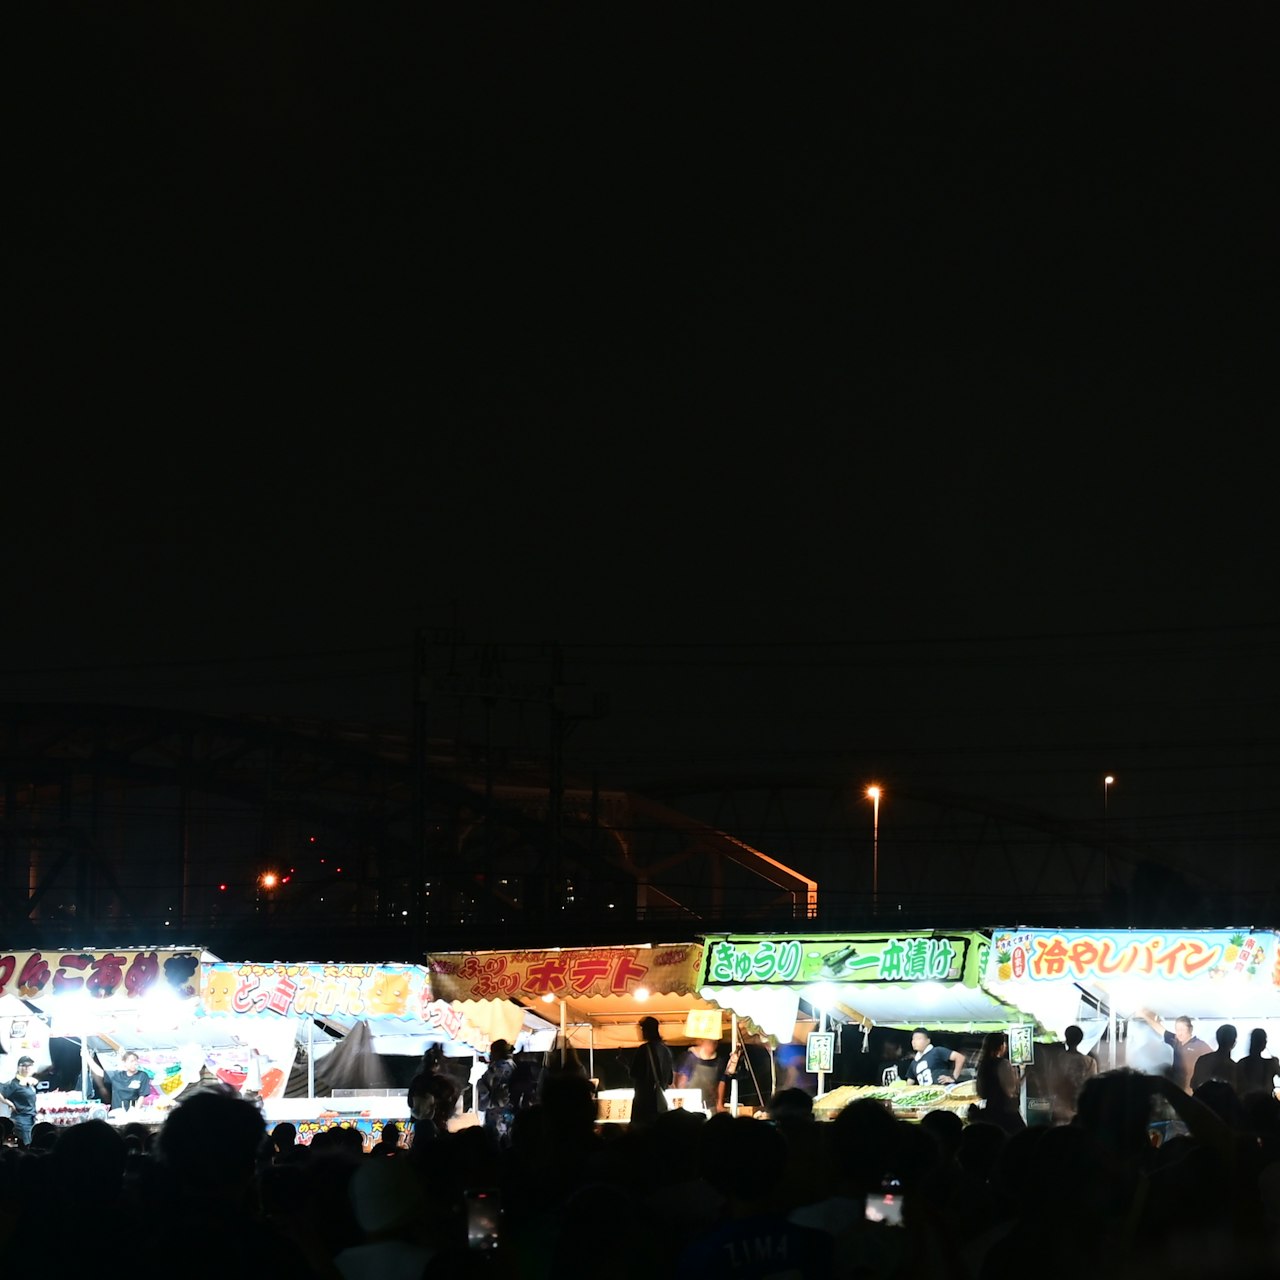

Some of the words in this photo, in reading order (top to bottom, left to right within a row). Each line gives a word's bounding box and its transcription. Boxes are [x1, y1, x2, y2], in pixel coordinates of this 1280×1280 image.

[457, 955, 507, 979] ふり
[470, 973, 520, 995] ふり
[521, 956, 649, 995] ポテト
[714, 940, 802, 981] きゅうり
[845, 938, 956, 980] 一本漬け
[1033, 938, 1218, 977] 冷やしパイン
[722, 1233, 789, 1269] ZIMA
